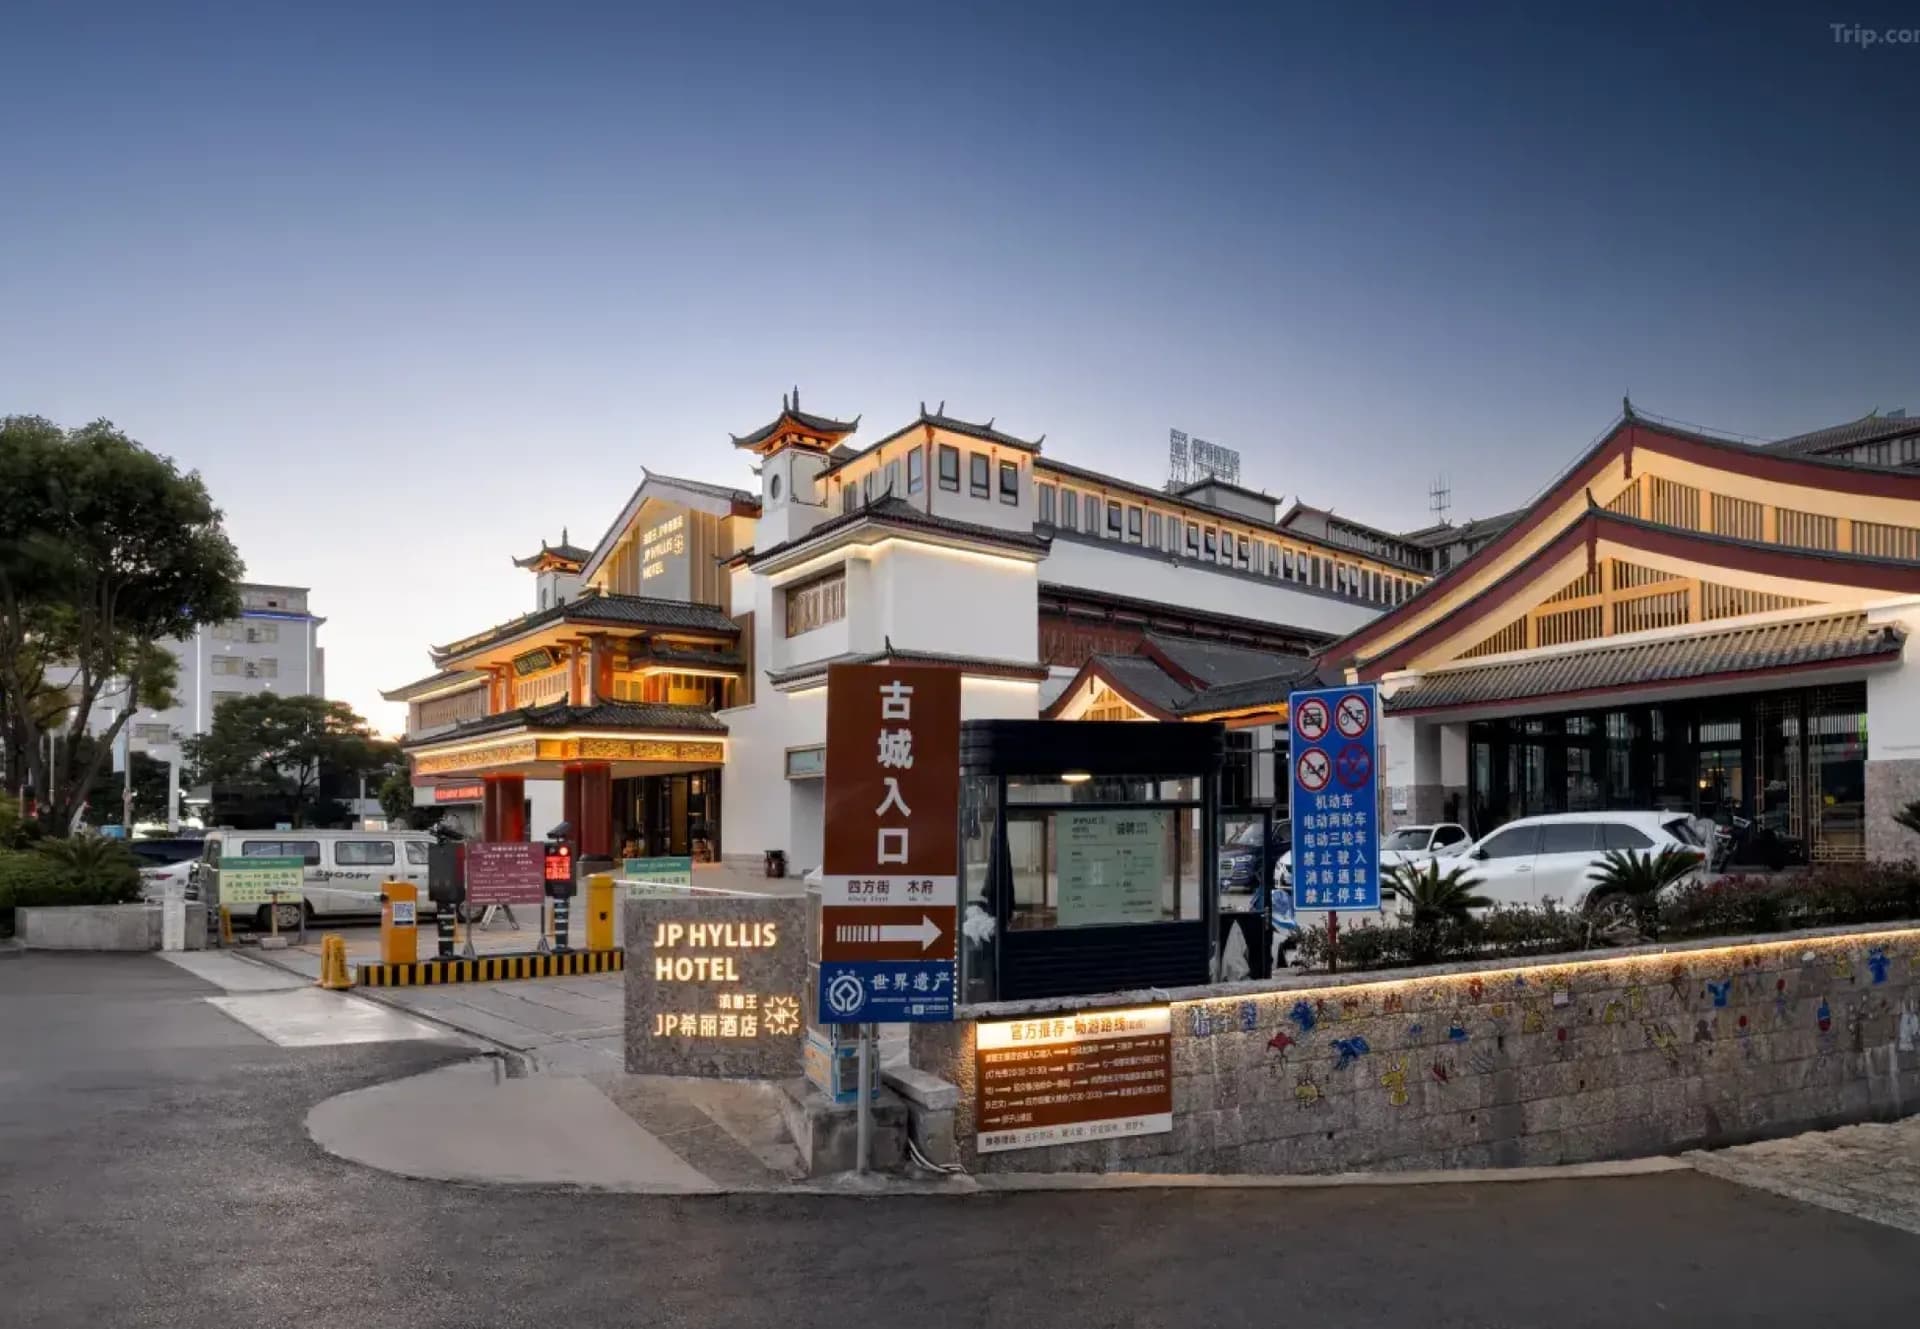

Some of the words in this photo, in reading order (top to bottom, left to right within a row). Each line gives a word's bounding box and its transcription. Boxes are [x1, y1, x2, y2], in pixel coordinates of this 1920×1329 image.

[874, 681, 914, 865] 古城入口
[1315, 793, 1353, 809] 机动车
[1303, 811, 1367, 829] 电动两轮车
[1303, 830, 1367, 848] 电动三轮车
[315, 870, 371, 880] SNOOPY
[847, 879, 890, 894] 四方街
[907, 879, 934, 895] 木府
[1305, 887, 1367, 904] 禁止停车
[654, 923, 684, 948] JP
[689, 923, 777, 948] HYLLIS
[655, 957, 739, 981] HOTEL
[654, 1014, 758, 1038] JP希丽酒店
